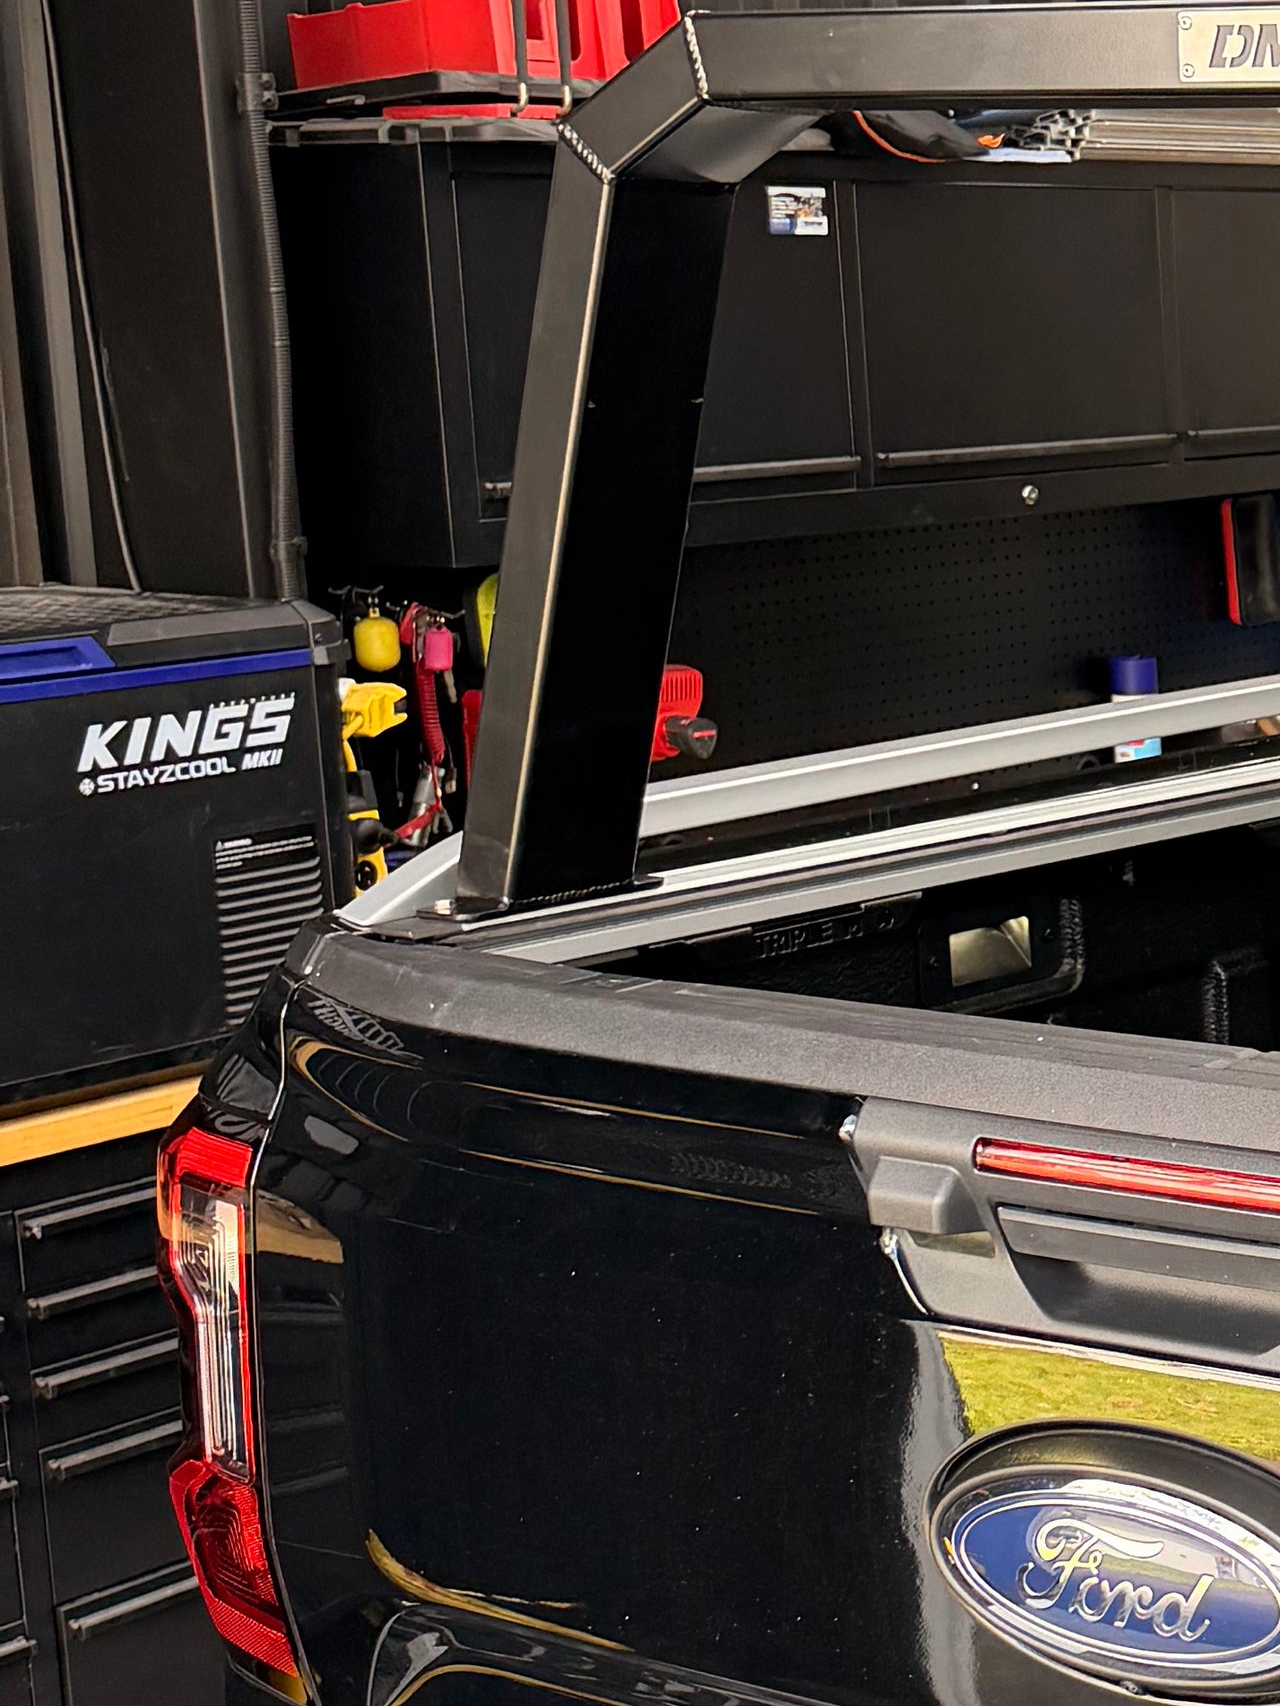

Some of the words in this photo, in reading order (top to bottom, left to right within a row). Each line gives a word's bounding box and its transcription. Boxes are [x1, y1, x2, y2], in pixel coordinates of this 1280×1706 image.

[77, 697, 296, 773] KINGS
[97, 756, 237, 793] STAYZCOOL
[241, 748, 284, 771] MKII
[1014, 1517, 1216, 1643] Ford
